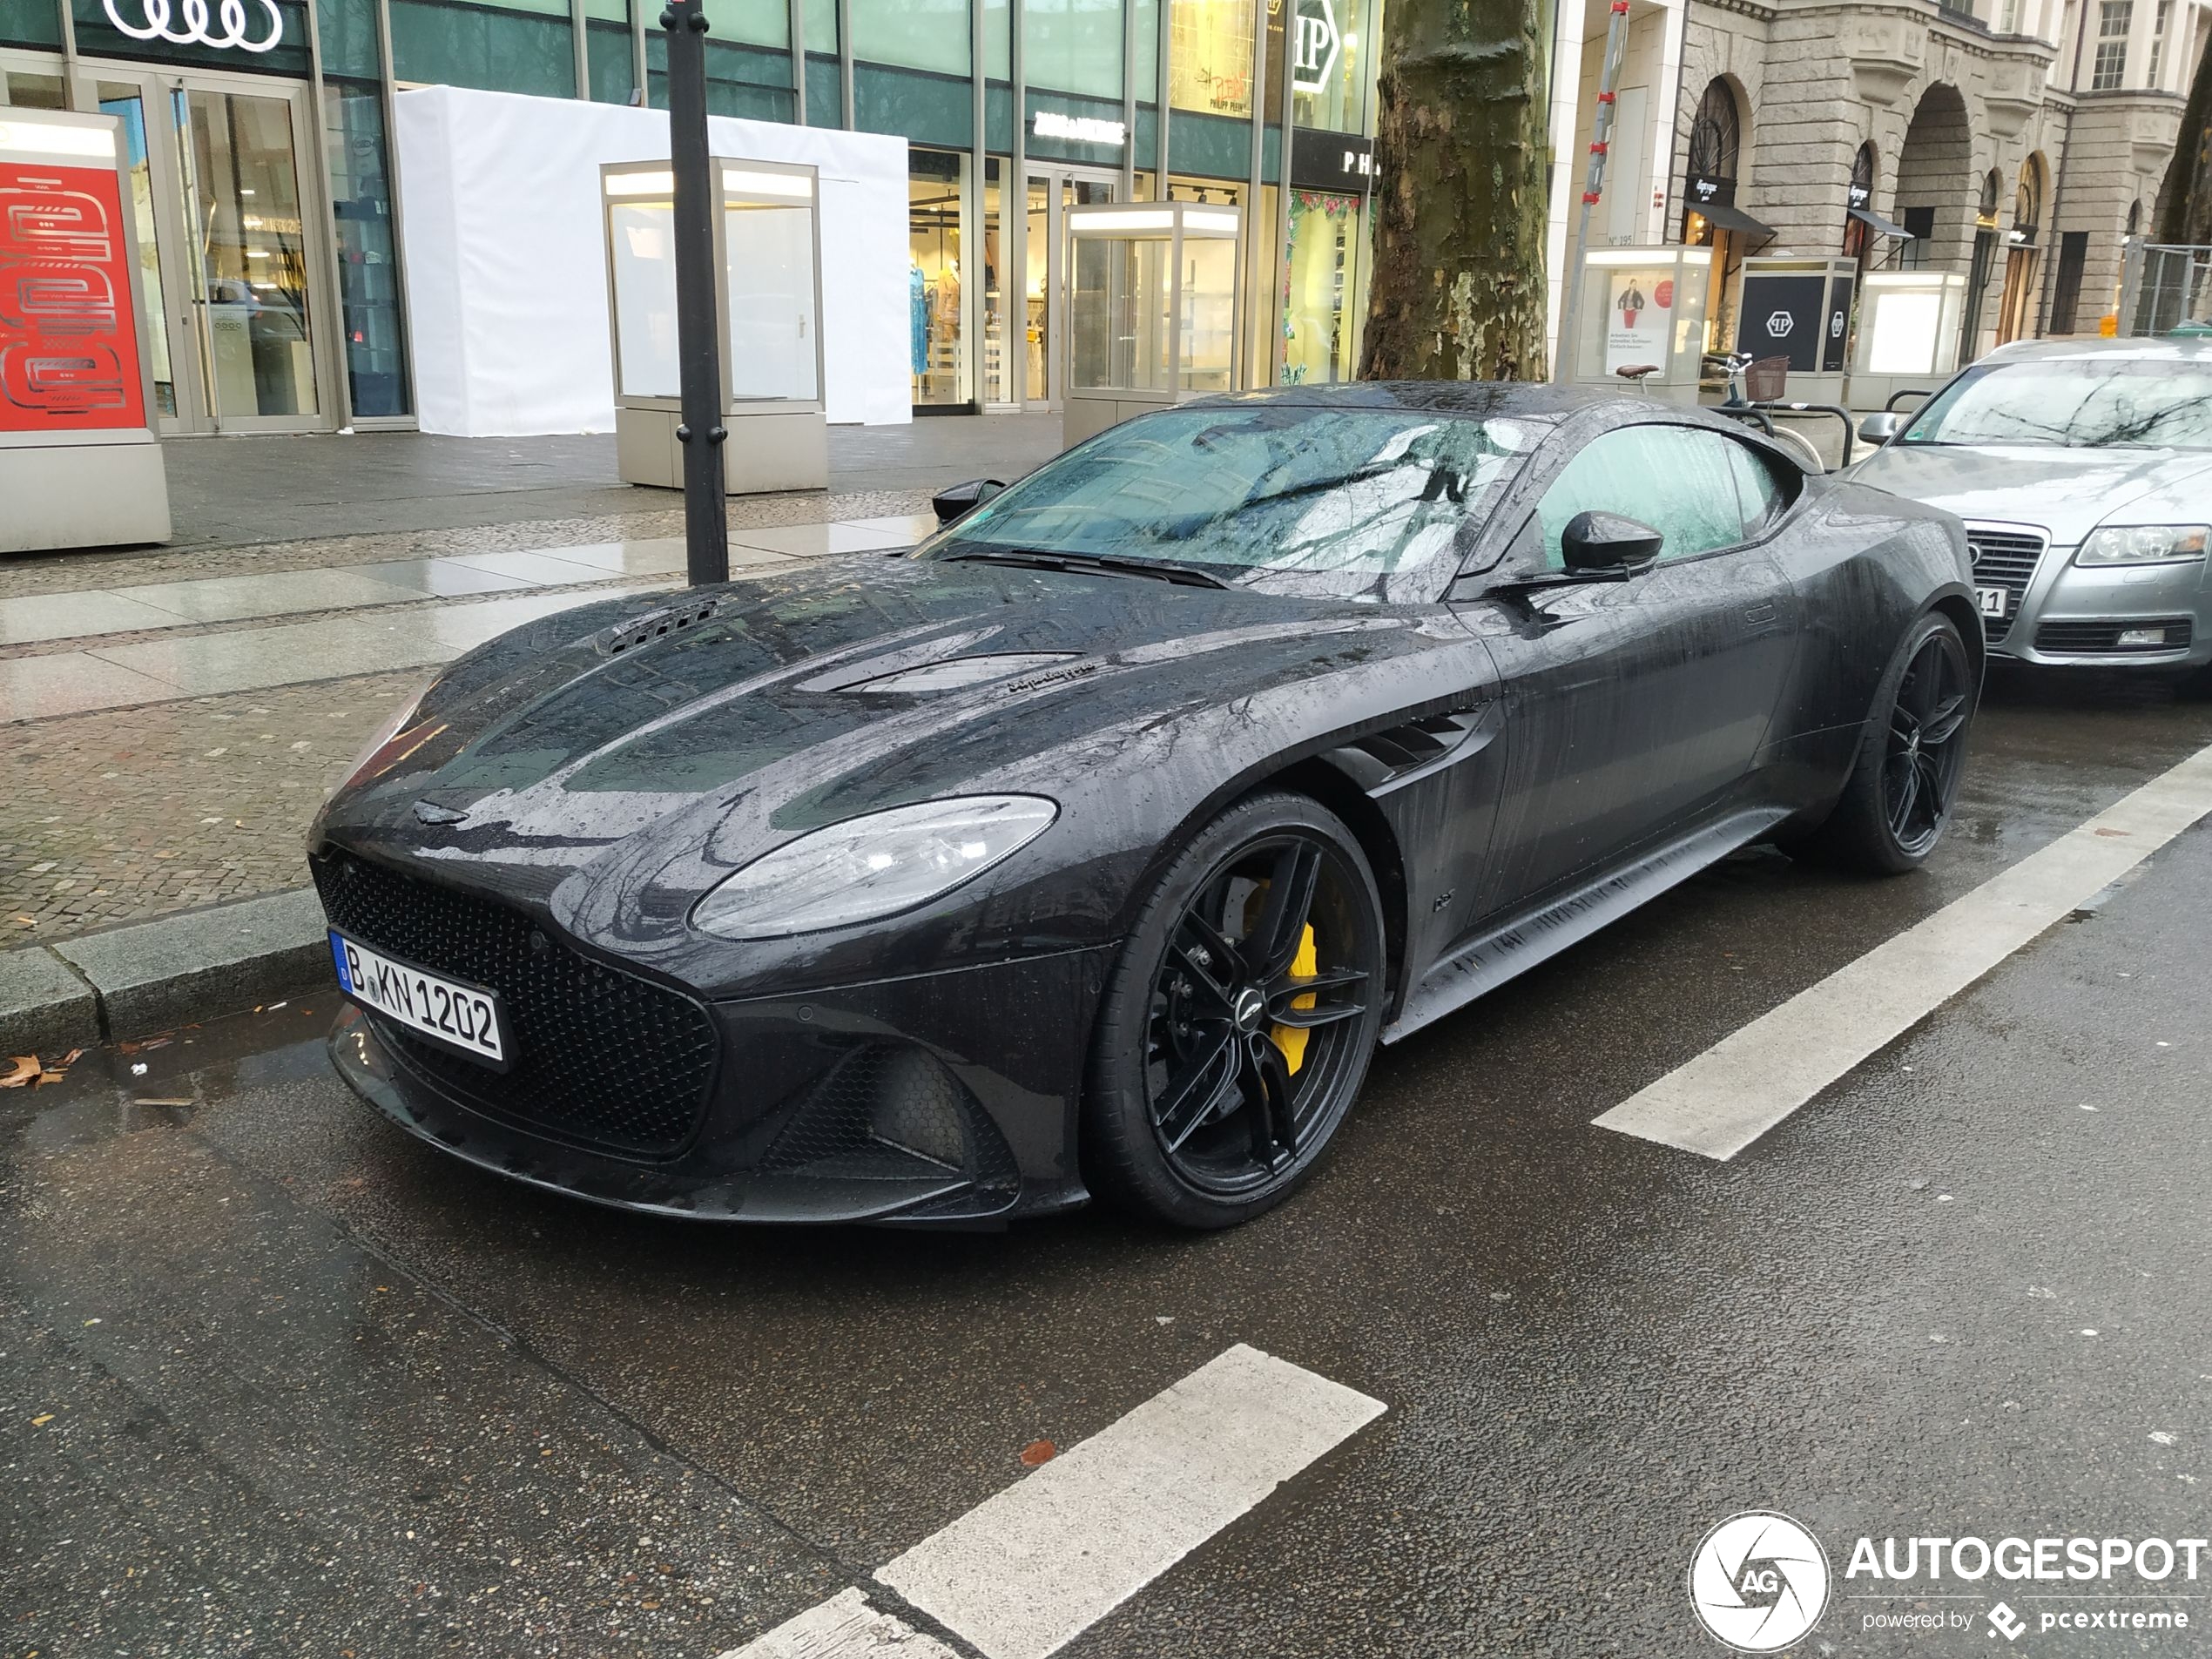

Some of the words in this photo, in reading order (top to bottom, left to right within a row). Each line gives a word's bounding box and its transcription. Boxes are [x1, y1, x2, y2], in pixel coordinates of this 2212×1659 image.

[1344, 151, 1381, 176] PH
[1620, 234, 1632, 246] 195
[347, 944, 365, 992] B
